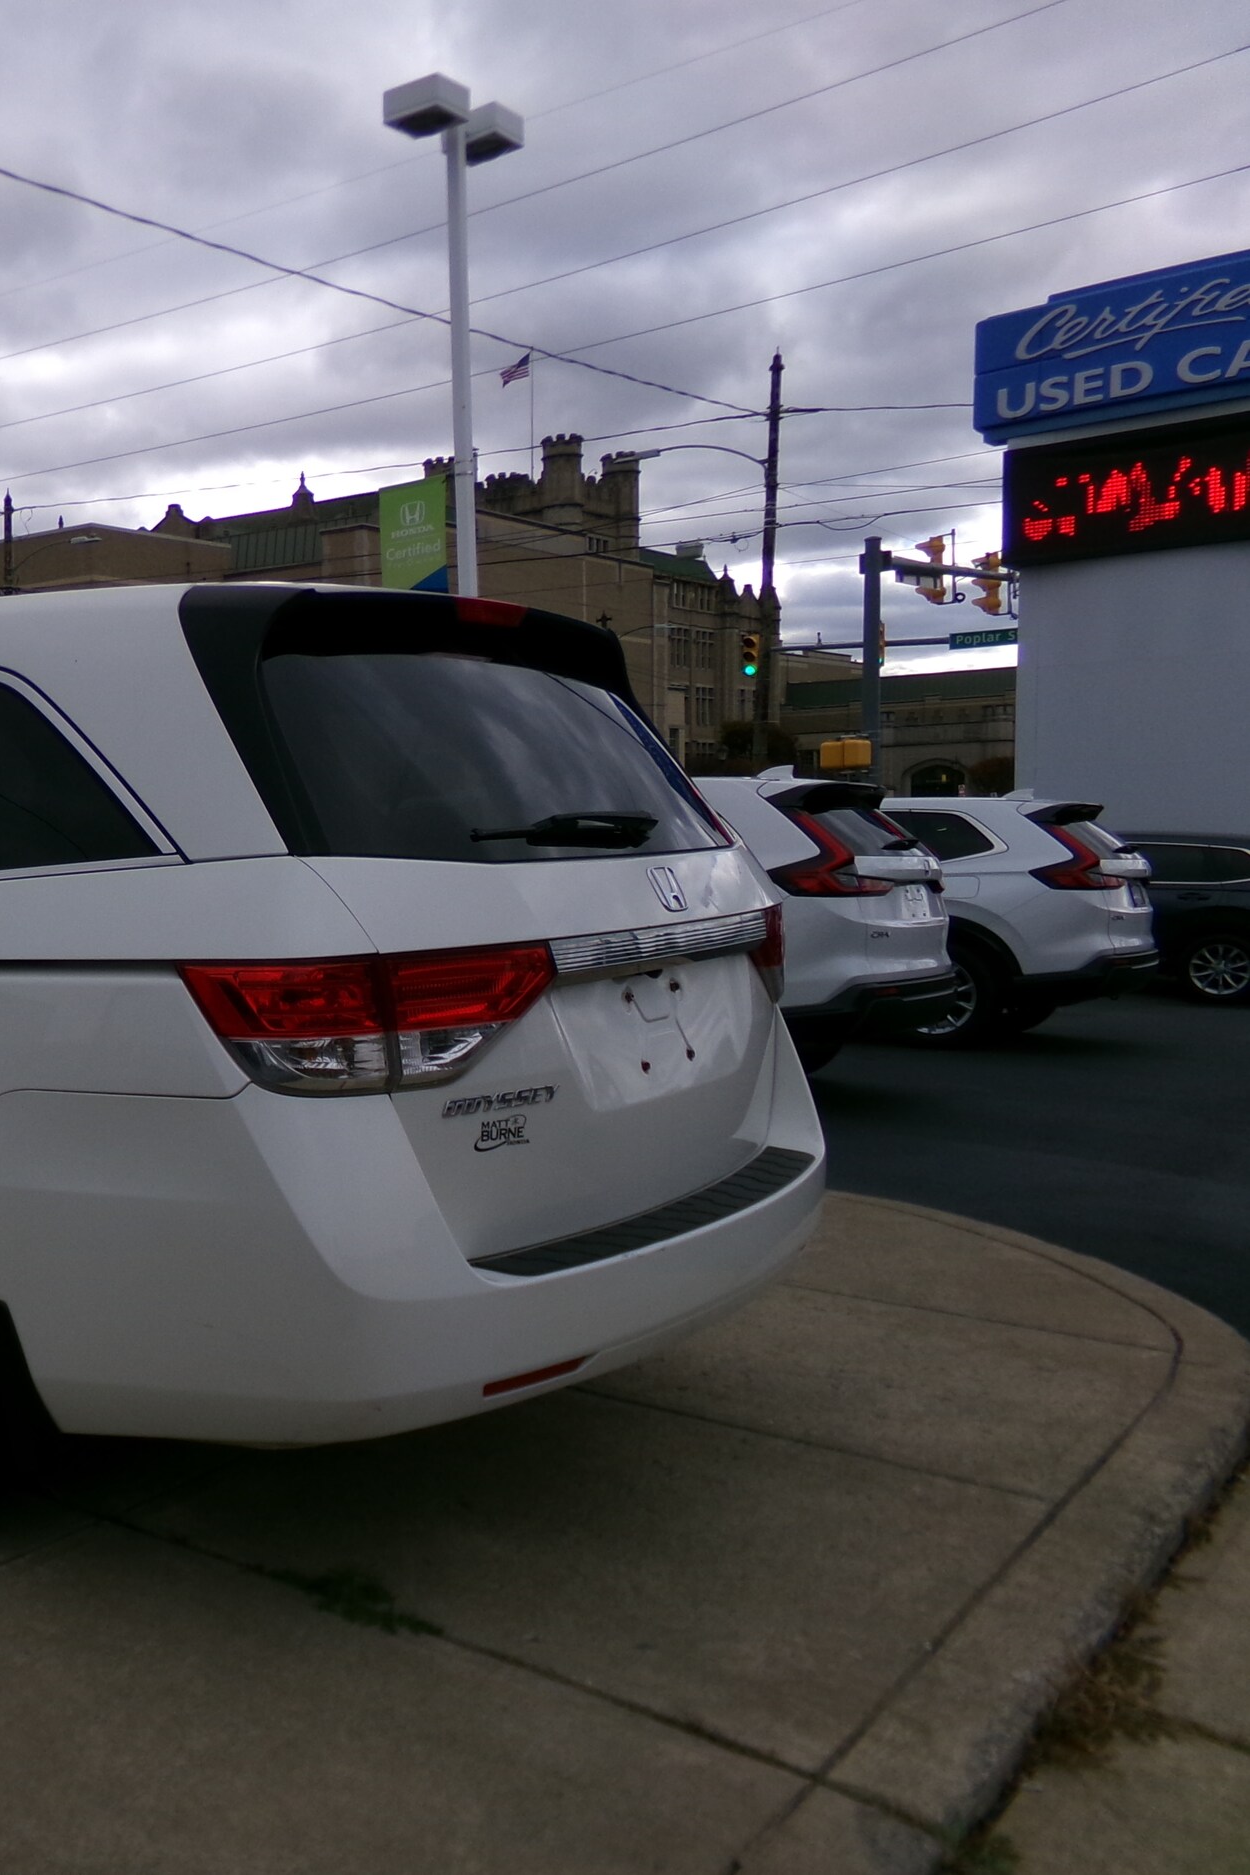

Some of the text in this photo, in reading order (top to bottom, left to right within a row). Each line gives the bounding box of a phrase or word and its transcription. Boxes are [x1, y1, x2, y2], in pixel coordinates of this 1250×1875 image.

[997, 361, 1153, 419] USED
[391, 524, 435, 539] HONDA
[386, 538, 441, 560] Certified
[956, 631, 1017, 645] Poplar S
[442, 1084, 560, 1118] ODYSSEY
[481, 1119, 510, 1130] MATT
[481, 1126, 525, 1142] BURNE
